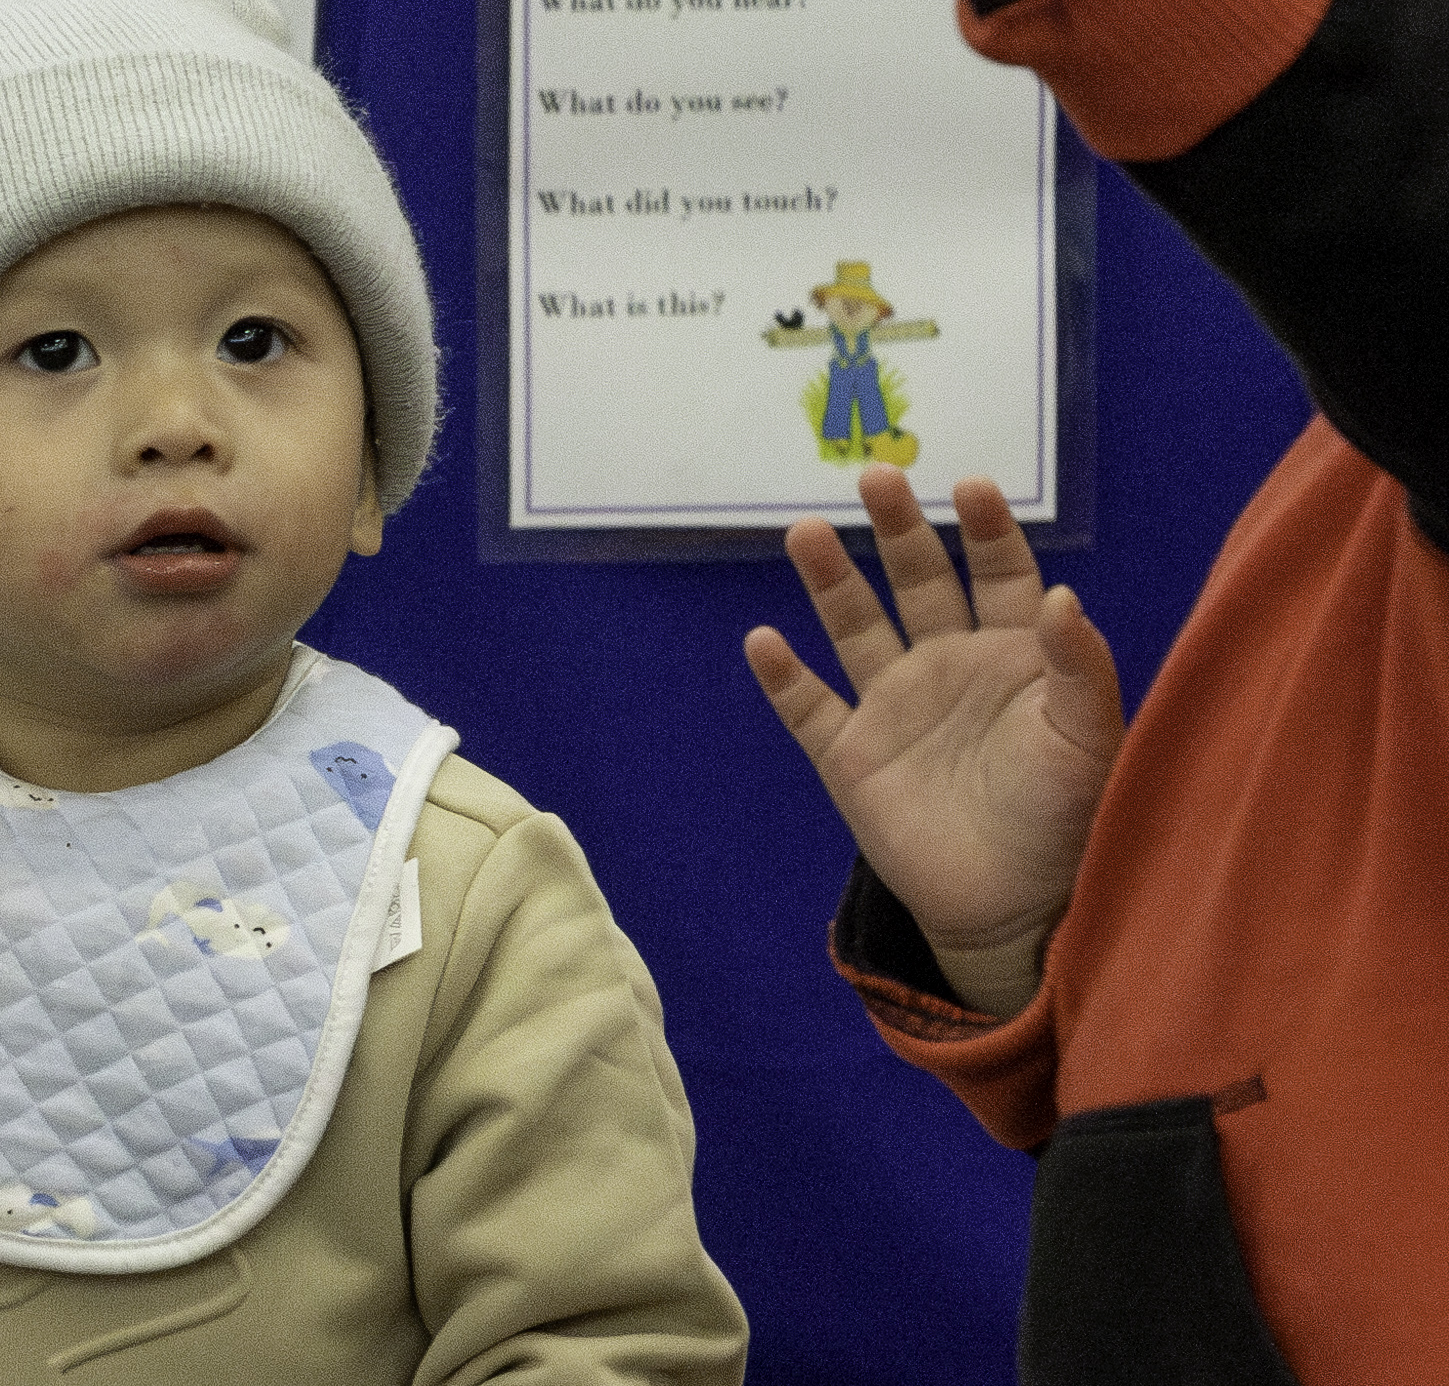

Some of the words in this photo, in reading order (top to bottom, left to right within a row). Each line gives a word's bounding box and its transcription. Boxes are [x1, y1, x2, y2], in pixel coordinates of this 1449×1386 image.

[536, 87, 617, 115] What
[624, 86, 662, 114] do
[669, 94, 723, 123] you
[730, 84, 790, 113] see?
[536, 188, 617, 217] What
[623, 186, 671, 215] did
[679, 193, 734, 223] you
[740, 183, 840, 214] touch?
[537, 291, 617, 319] What
[625, 290, 649, 317] is
[656, 287, 727, 317] this?
